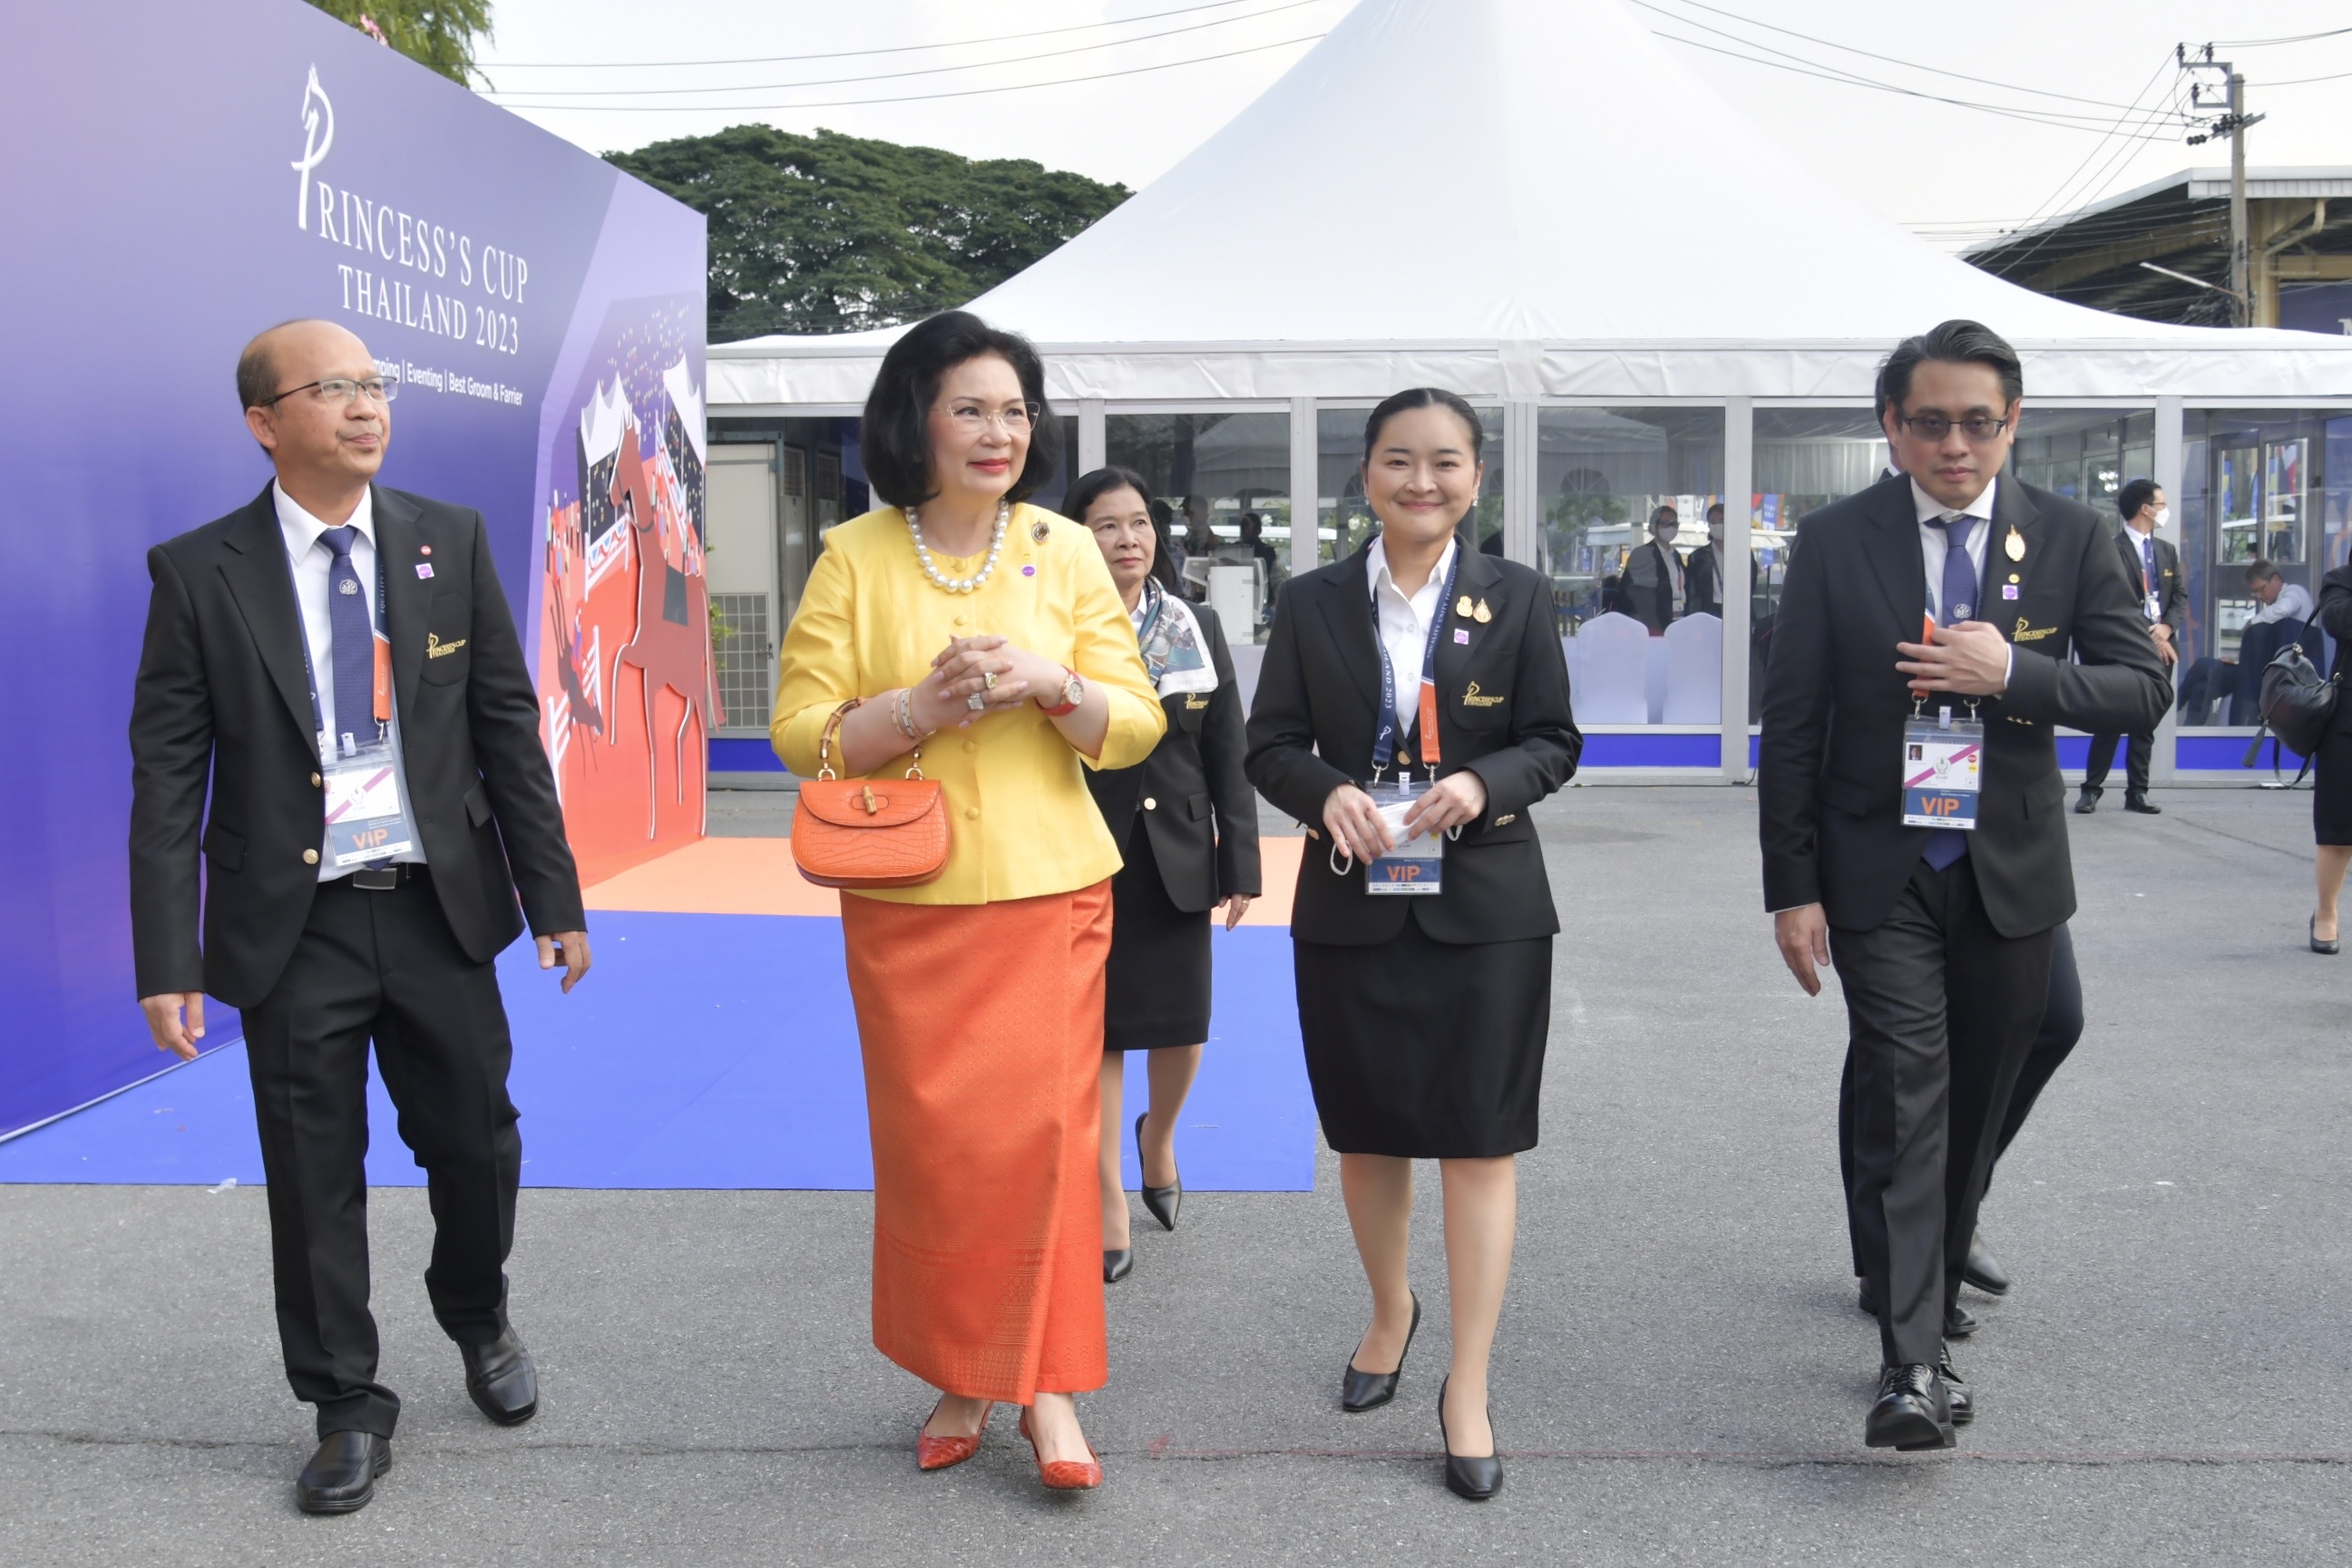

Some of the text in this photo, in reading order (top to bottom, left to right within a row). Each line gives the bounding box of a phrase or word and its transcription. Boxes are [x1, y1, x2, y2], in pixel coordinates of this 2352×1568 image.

[483, 245, 529, 304] CUP
[338, 264, 520, 355] THAILAND 2023
[407, 363, 443, 393] Eventing
[449, 373, 466, 394] Best
[467, 376, 492, 399] Groom
[493, 385, 499, 401] &
[500, 385, 523, 406] Farrier
[1427, 624, 1440, 658] EQUALITY
[1438, 602, 1449, 623] UNITY
[1384, 687, 1393, 709] 2023
[1921, 796, 1960, 816] VIP
[352, 828, 389, 851] VIP
[1386, 864, 1421, 882] VIP
